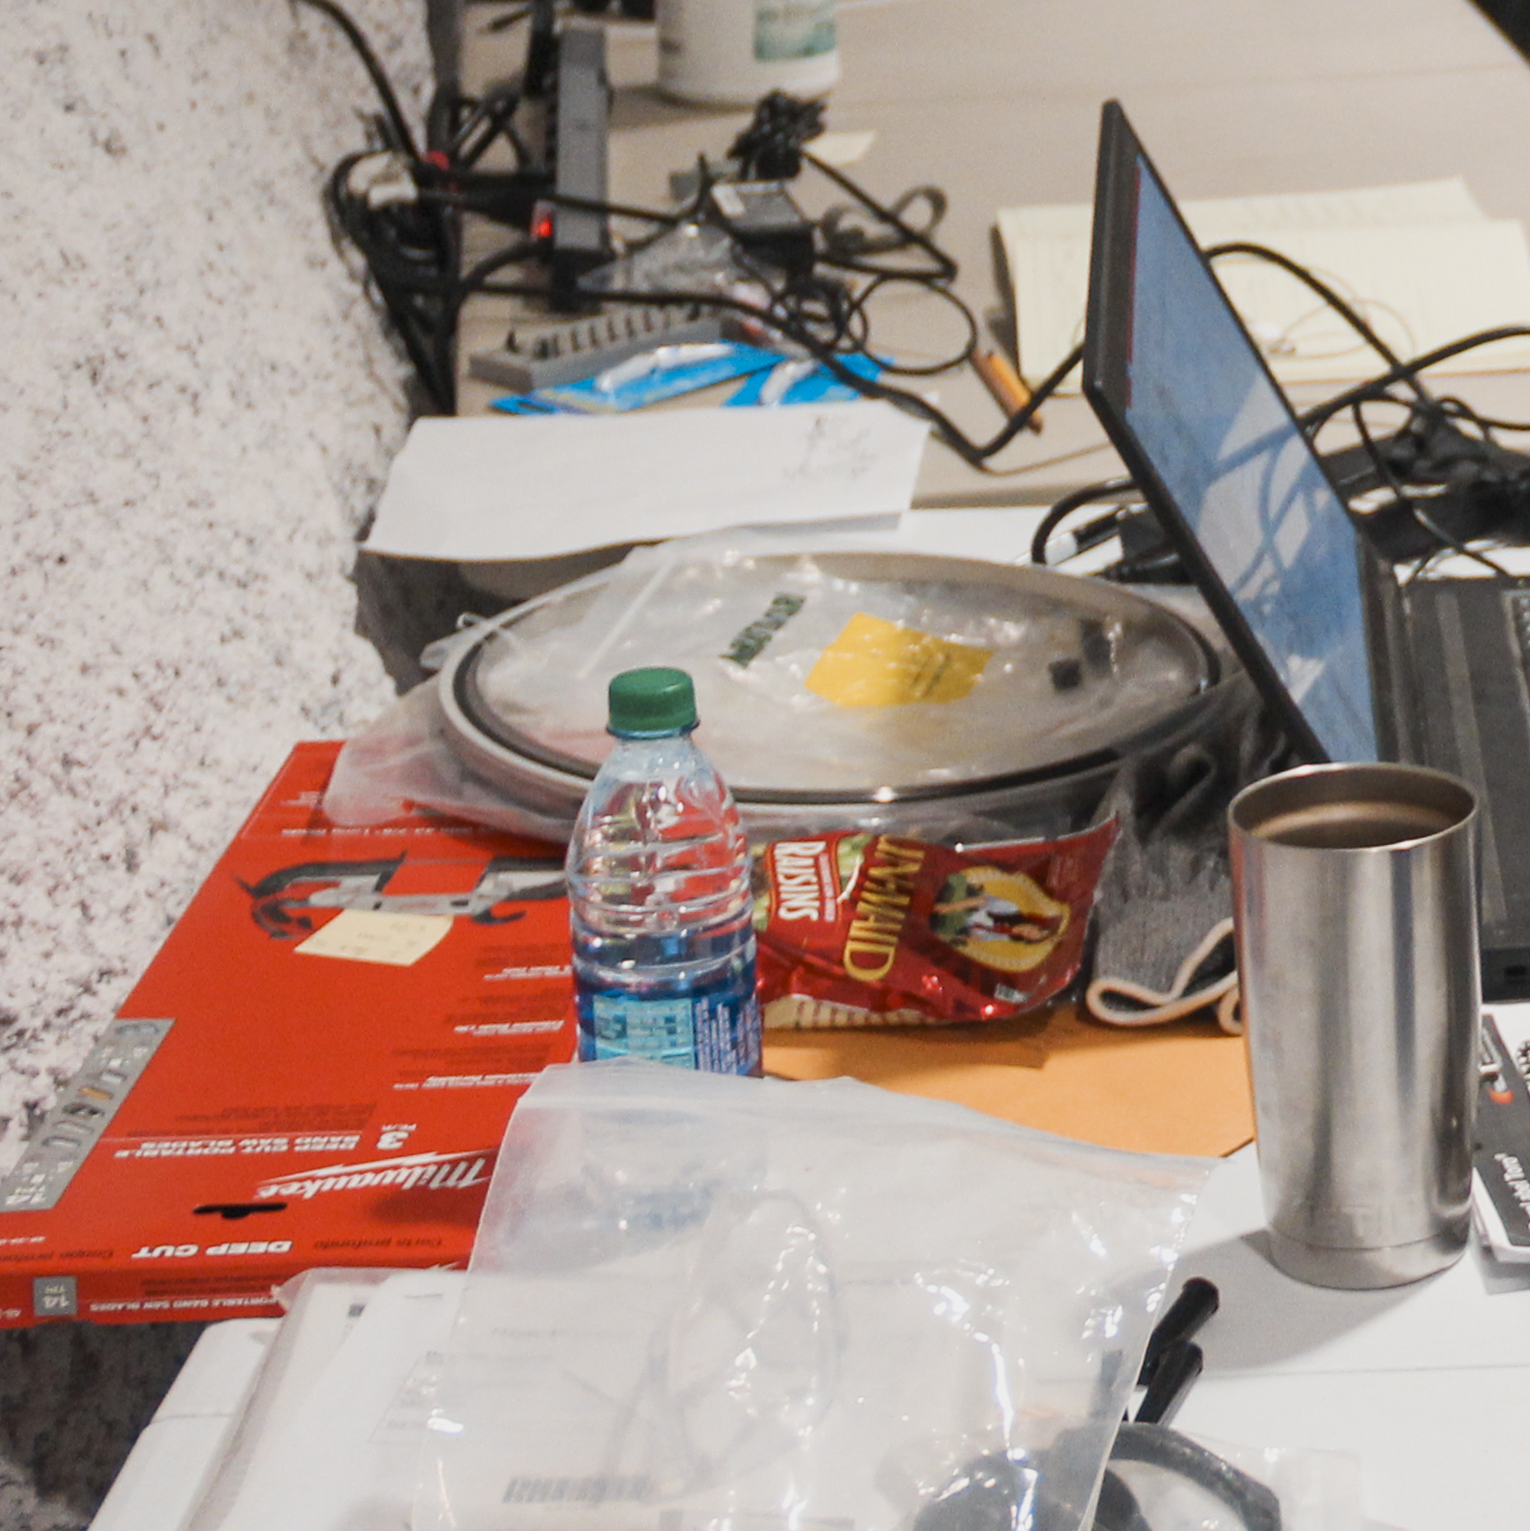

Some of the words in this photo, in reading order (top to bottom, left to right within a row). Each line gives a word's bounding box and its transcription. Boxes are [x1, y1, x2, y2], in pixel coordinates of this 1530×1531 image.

[773, 841, 827, 921] RAISINS
[377, 1131, 409, 1151] 3
[254, 1157, 489, 1199] Milwaukee
[131, 1244, 199, 1259] CUT
[205, 1240, 293, 1255] DEEP
[43, 1294, 71, 1309] 14
